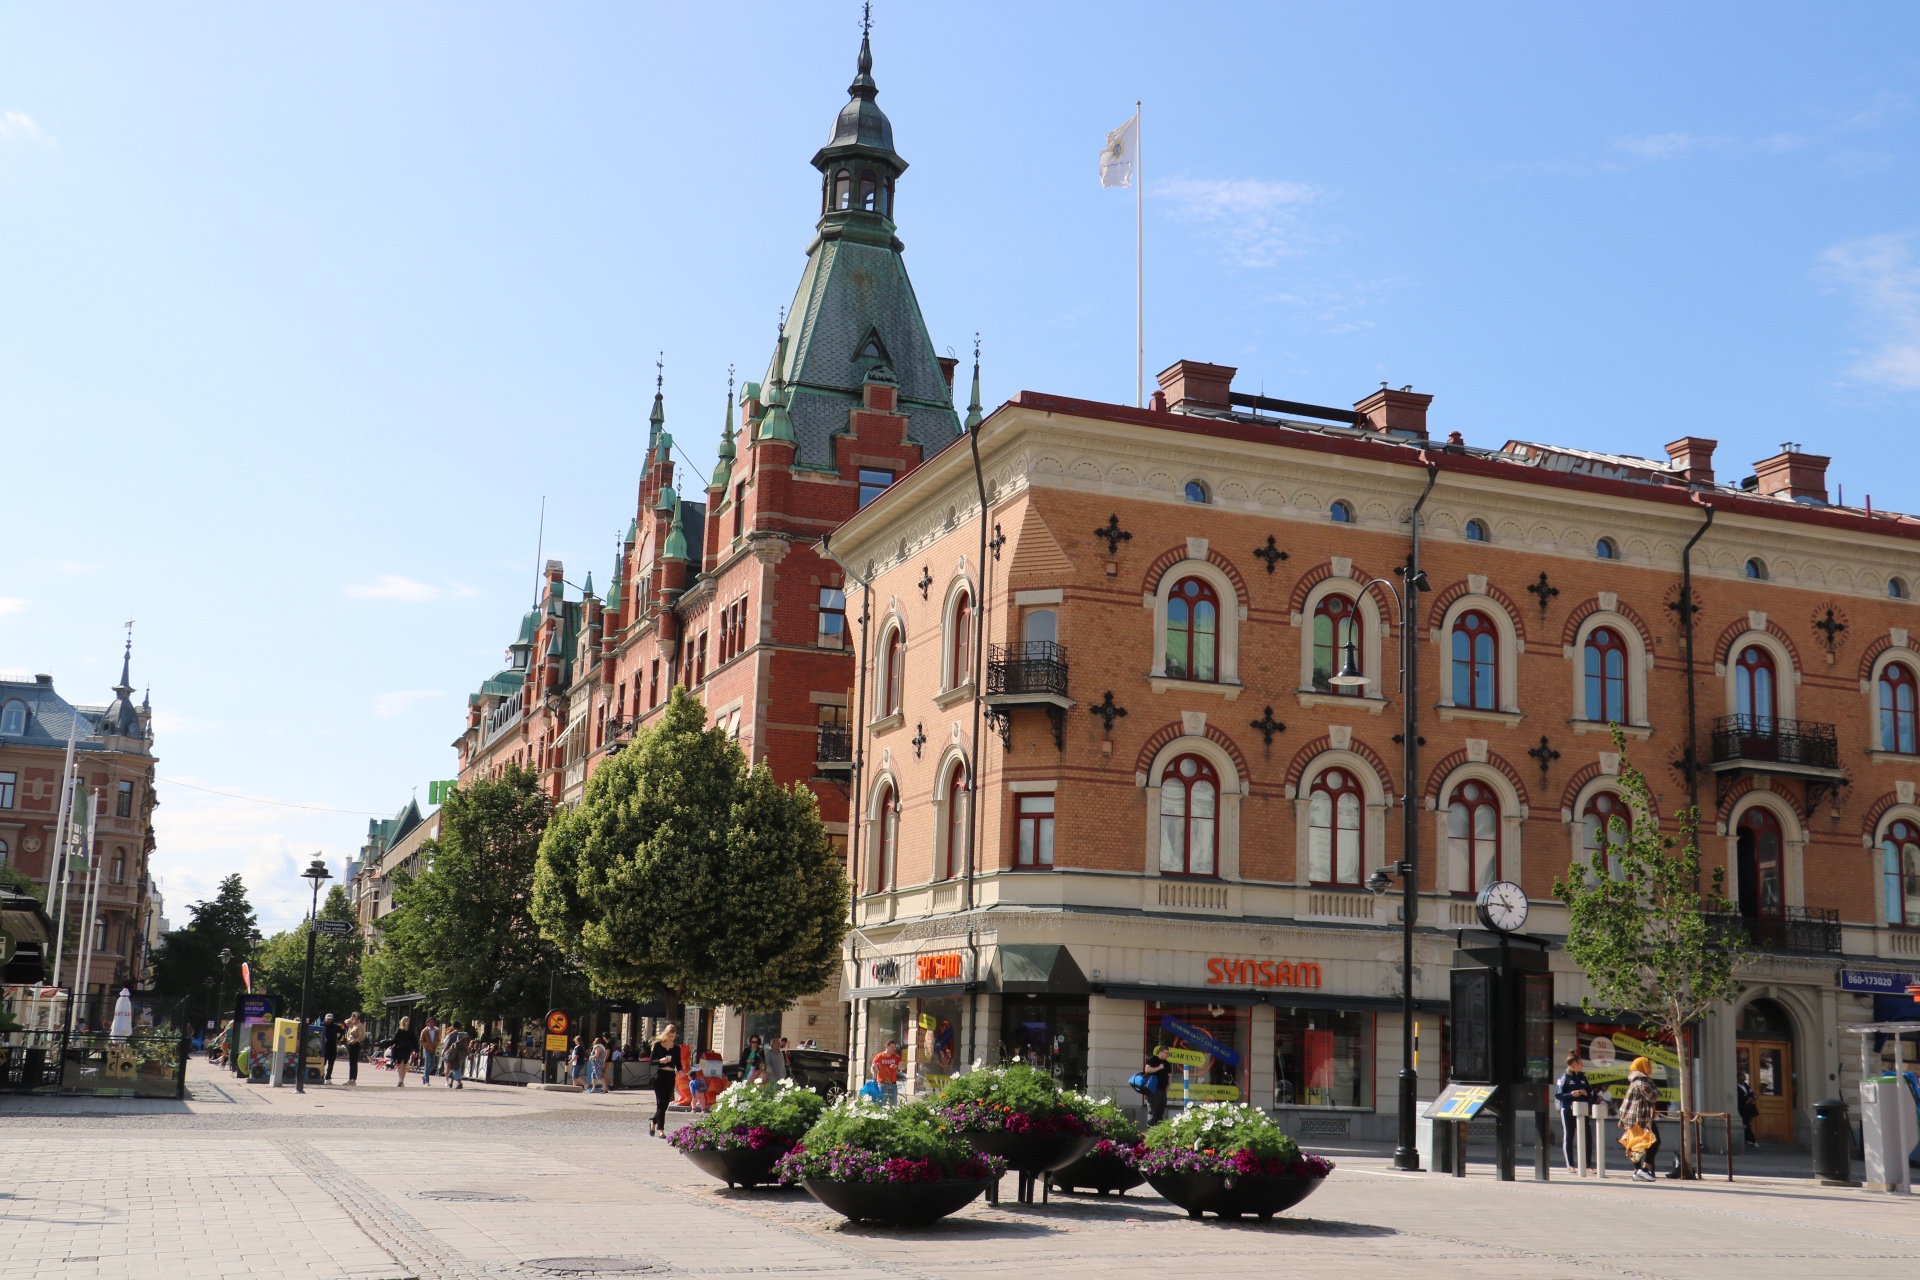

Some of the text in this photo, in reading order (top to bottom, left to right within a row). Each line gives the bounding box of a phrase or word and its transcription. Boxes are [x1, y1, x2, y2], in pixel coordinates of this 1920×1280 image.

[1207, 957, 1322, 989] SYNSAM
[1848, 975, 1892, 987] 060-173020
[1827, 1038, 1833, 1048] 4
